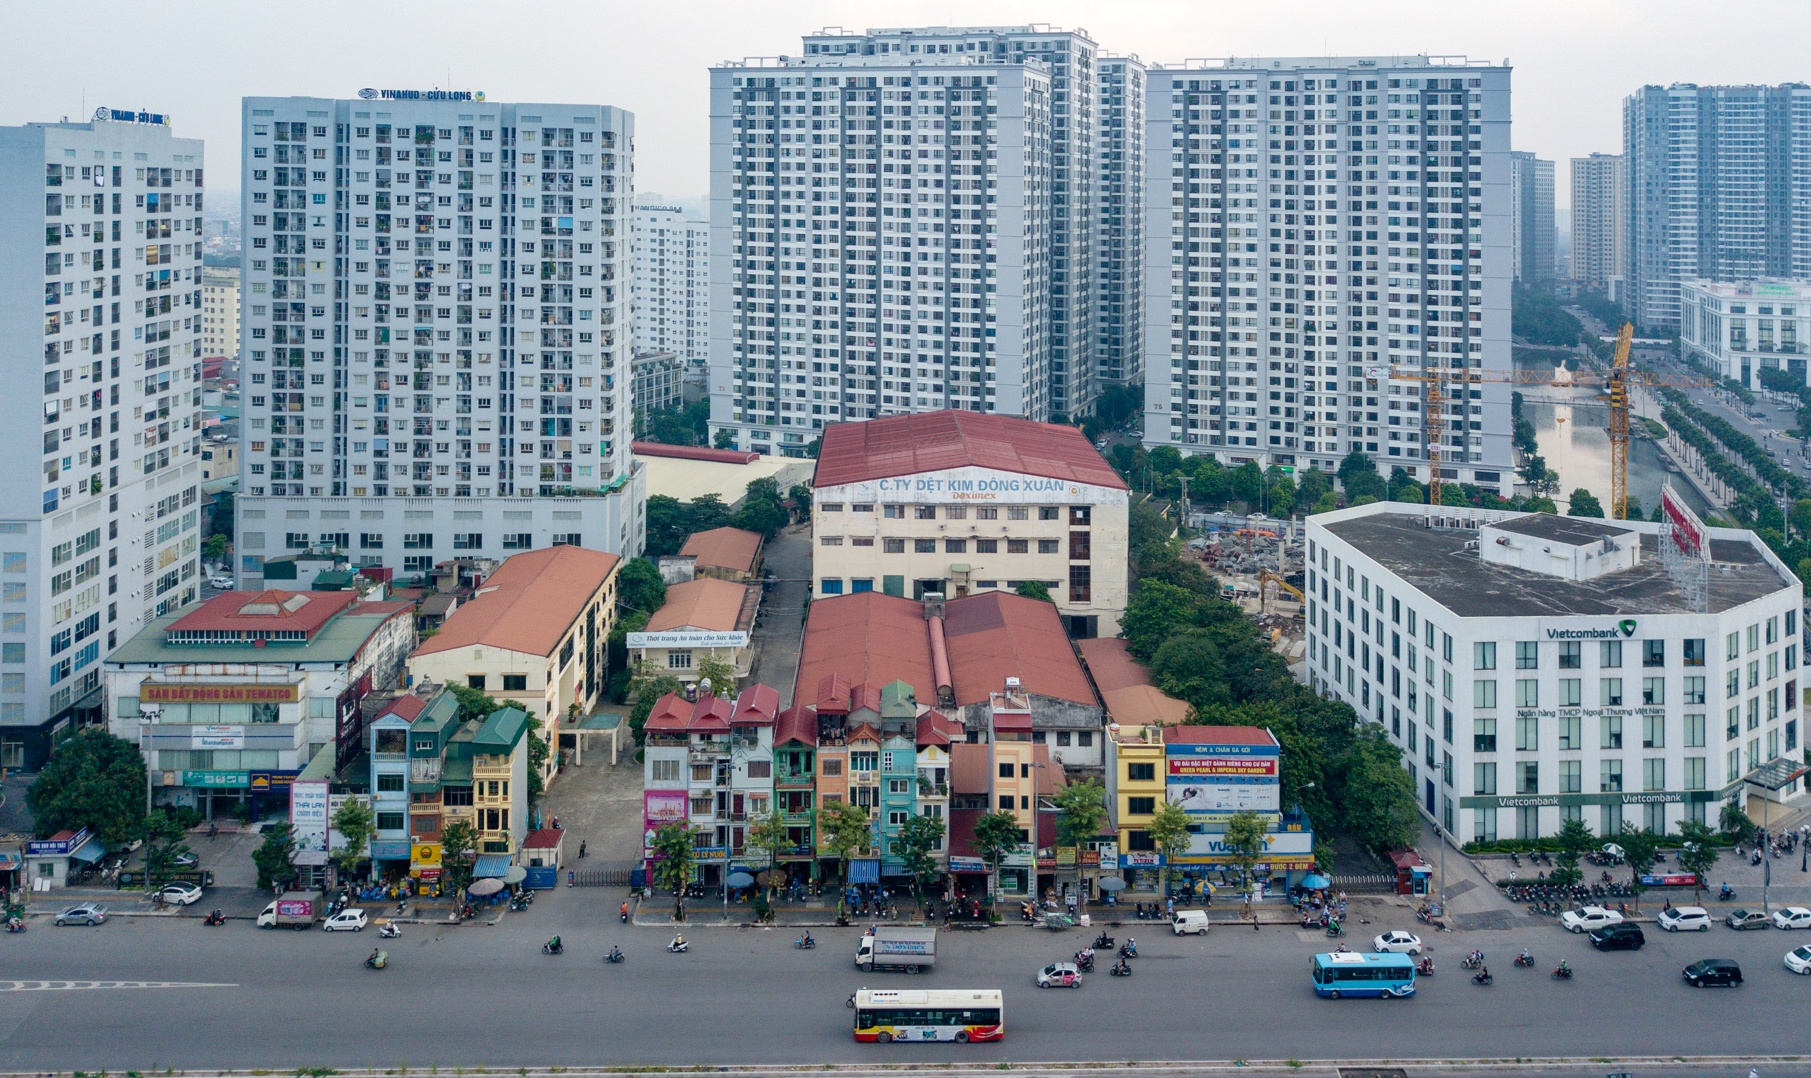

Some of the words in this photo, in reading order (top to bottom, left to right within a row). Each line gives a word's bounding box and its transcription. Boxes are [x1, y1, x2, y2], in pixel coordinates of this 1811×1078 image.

[381, 89, 420, 99] VINAHUD
[427, 87, 447, 100] CỬU
[448, 91, 472, 100] LONG
[879, 479, 911, 491] C.TY
[917, 478, 943, 493] DỆT
[948, 480, 973, 491] KIM
[978, 477, 1019, 491] ĐÔNG
[1023, 478, 1065, 491] XUÂN
[646, 634, 660, 642] Thời
[660, 635, 678, 643] trang
[716, 633, 728, 641] Sức
[1547, 627, 1619, 639] Vietcombank
[1517, 708, 1537, 718] Ngân
[1538, 708, 1556, 718] hàng
[1558, 708, 1581, 716] TMCP
[1583, 707, 1604, 718] Ngoại
[1606, 706, 1633, 716] Thương
[1634, 706, 1649, 716] Việt
[1195, 746, 1208, 754] NỆM
[1498, 797, 1559, 807] Vietcombank
[1621, 793, 1681, 803] Vietcombank
